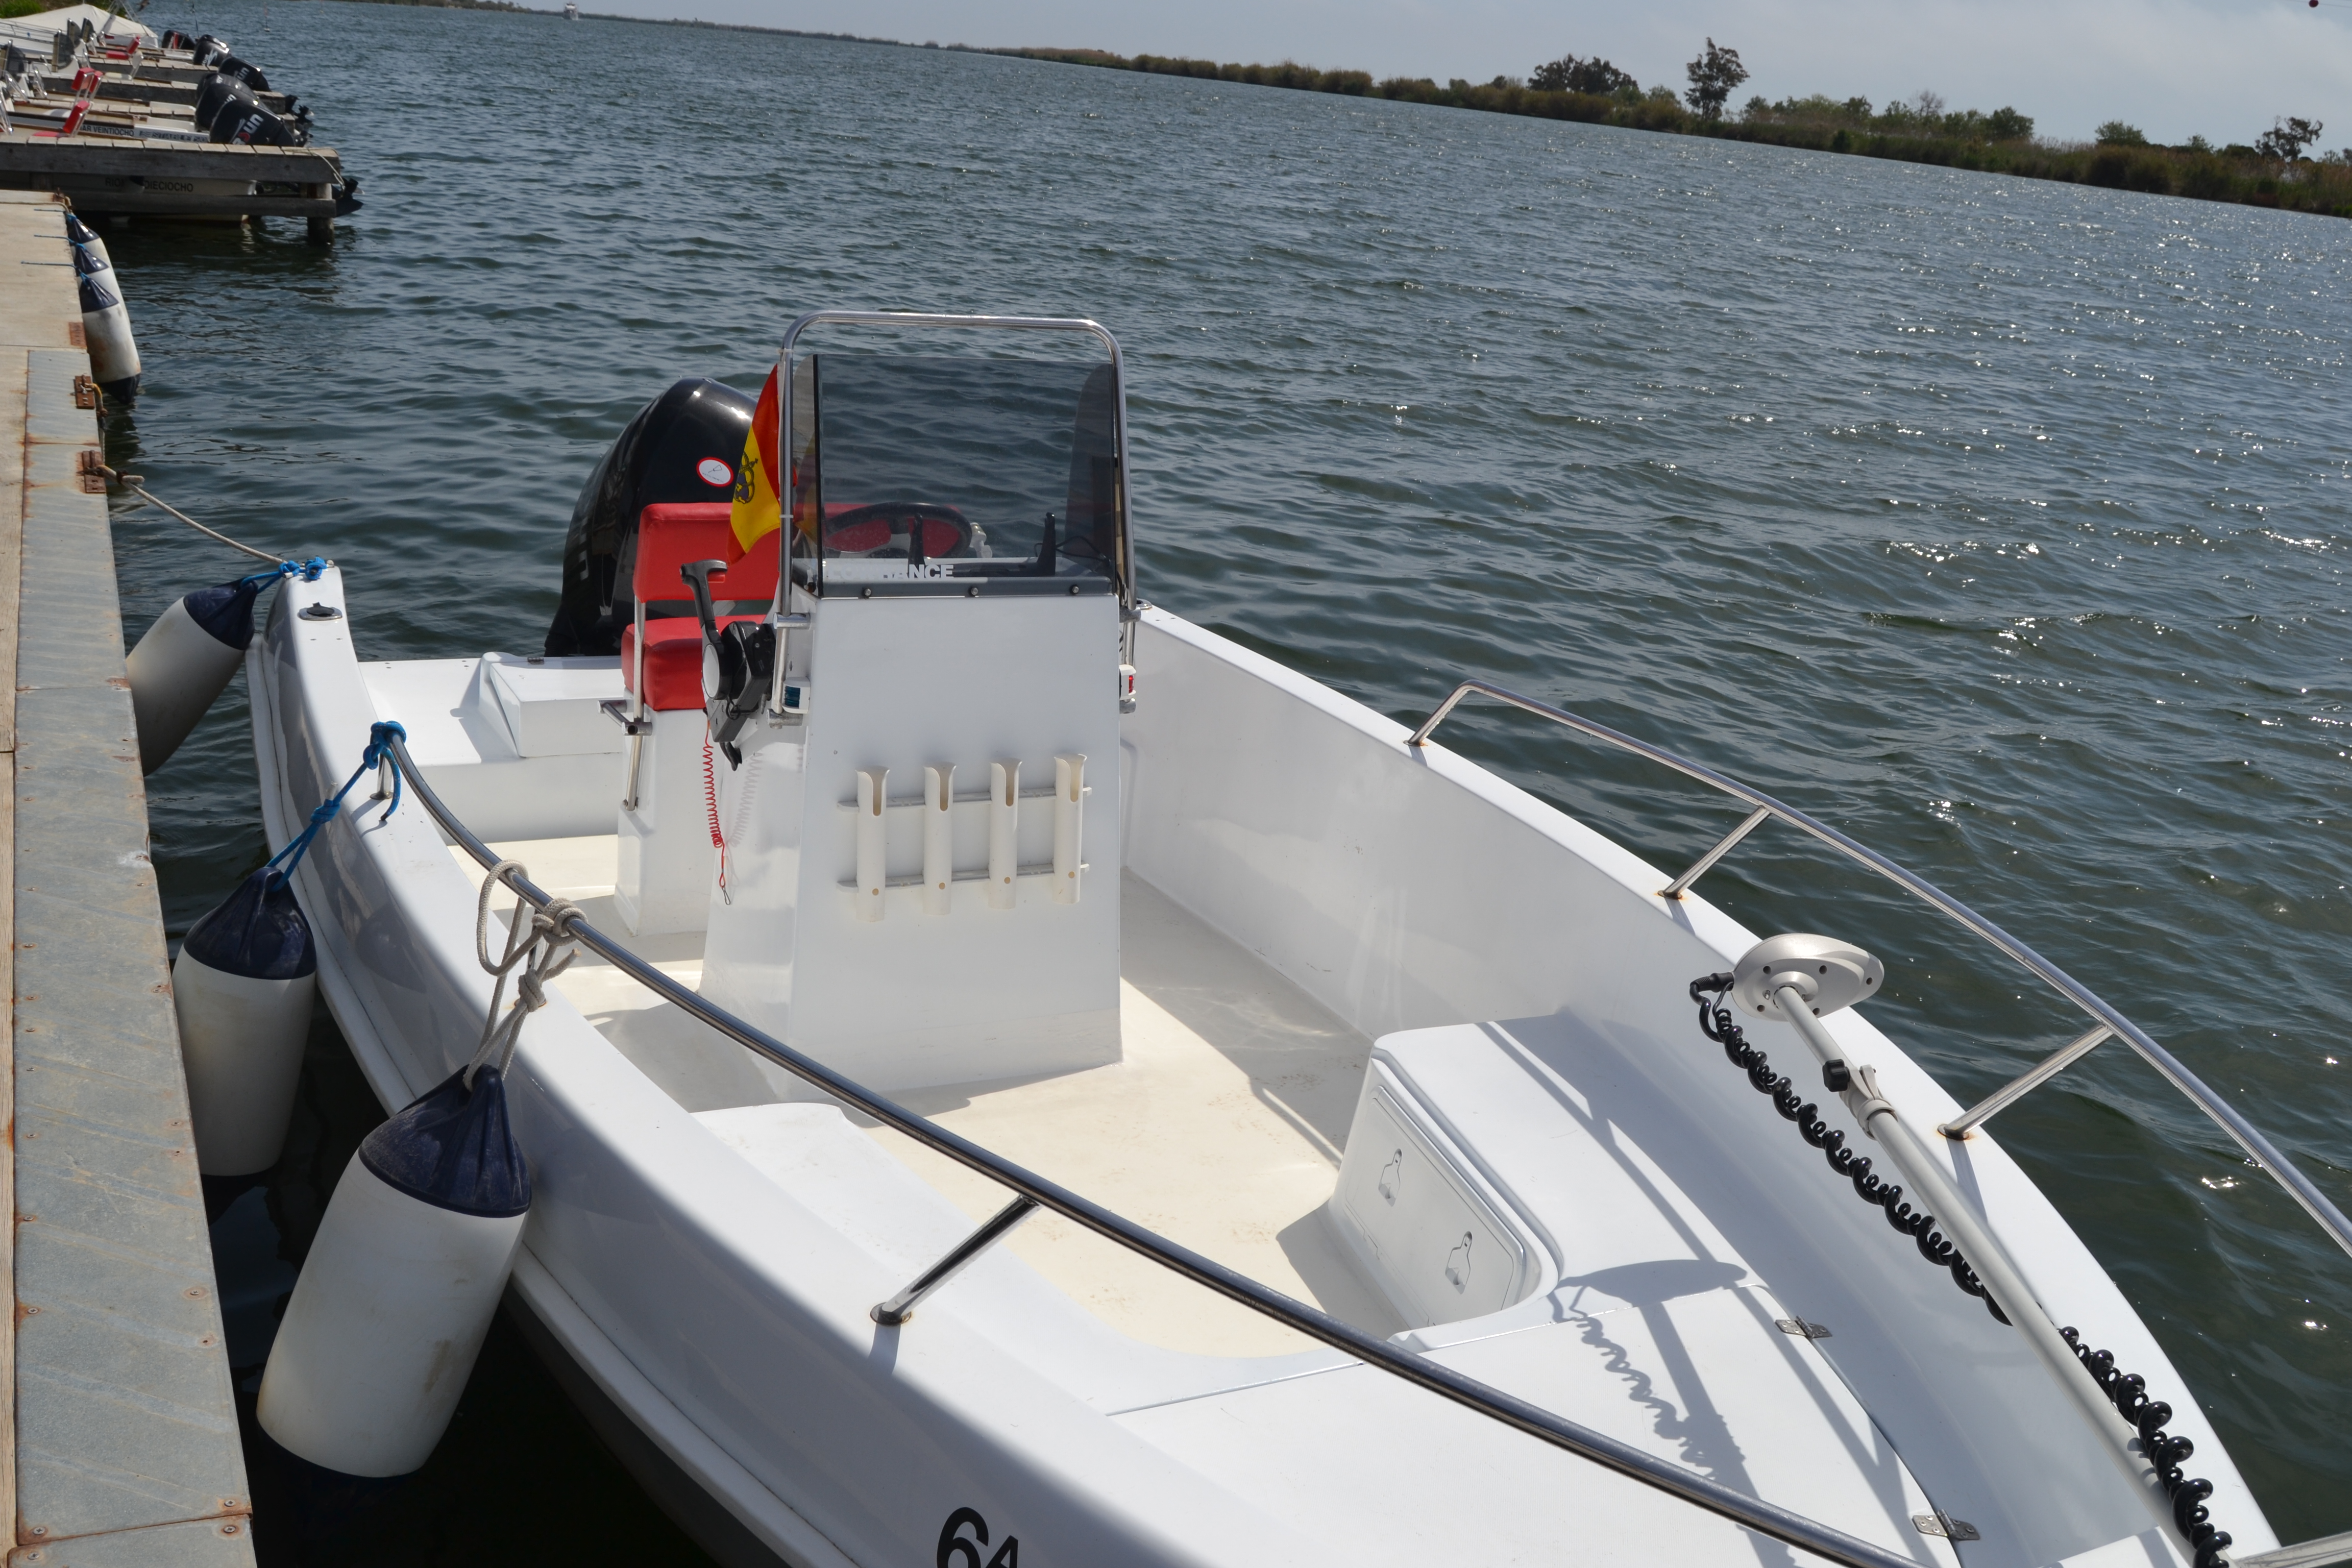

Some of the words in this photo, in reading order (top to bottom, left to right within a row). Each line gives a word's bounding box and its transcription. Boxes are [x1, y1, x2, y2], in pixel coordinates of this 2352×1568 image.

[92, 126, 134, 137] VEINTIOCHO
[143, 180, 193, 192] DIECIOCHO
[827, 564, 954, 580] LOWRANCE
